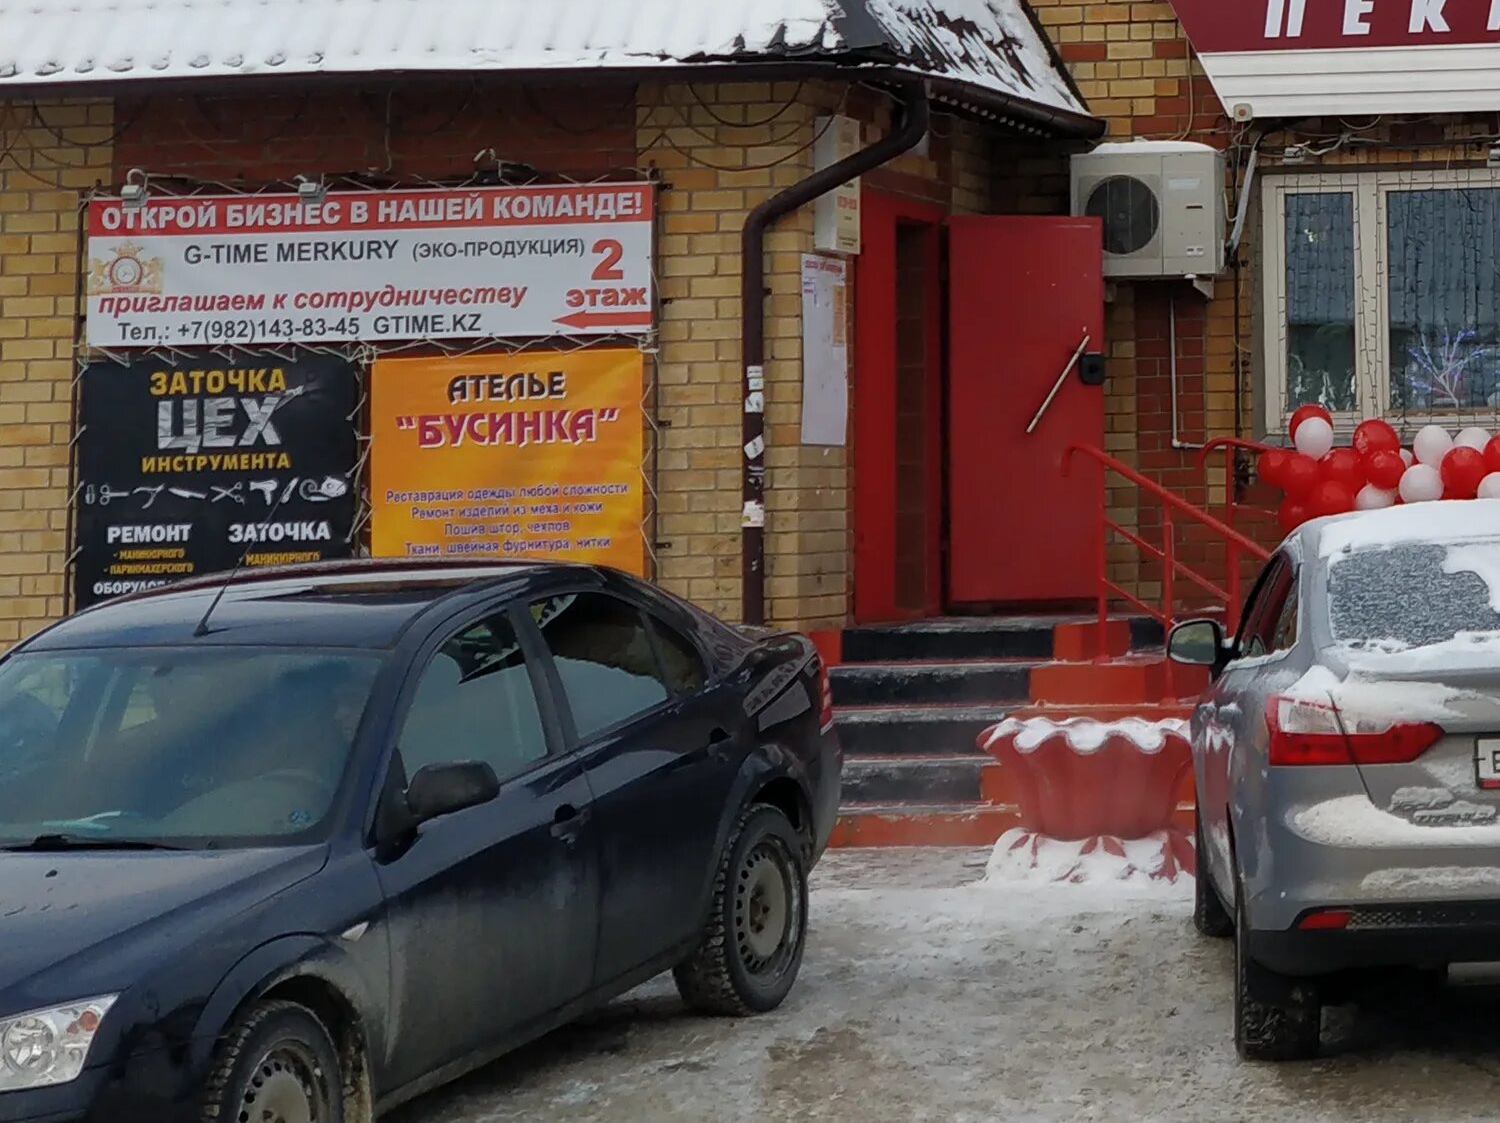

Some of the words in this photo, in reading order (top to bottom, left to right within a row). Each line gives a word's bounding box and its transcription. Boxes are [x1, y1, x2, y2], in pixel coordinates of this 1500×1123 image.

[102, 200, 217, 229] ОТКРОЙ
[226, 201, 342, 228] БИЗНЕС
[350, 200, 369, 225] В
[378, 193, 484, 223] НАШЕЙ
[493, 192, 642, 221] КОМАНДЕ!
[184, 242, 268, 264] G-TIME
[276, 239, 399, 263] MERKURY
[412, 238, 586, 262] (ЭКО-ПРОДУКЦИЯ)
[591, 238, 624, 281] 2
[98, 291, 265, 318] приглашаем
[272, 292, 289, 310] к
[293, 284, 528, 314] сотрудничеству
[565, 286, 648, 308] этаж
[118, 322, 170, 341] Тел.:
[178, 317, 360, 344] +7(982)143-83-45
[373, 313, 482, 334] GTIME.KZ
[150, 368, 287, 396] ЗАТОЧКА
[447, 371, 568, 406] АТЕЛЬЕ
[158, 396, 282, 454] ЦЕХ
[395, 407, 620, 448] "БУСИНКА"
[142, 452, 291, 474] ИНСТРУМЕНТА
[386, 490, 464, 503] Реставрация
[468, 487, 515, 500] одежды
[519, 484, 560, 497] любой
[562, 484, 629, 496] сложности
[411, 506, 456, 519] Ремонт
[459, 504, 509, 519] изделий
[513, 506, 527, 515] из
[530, 503, 559, 514] меха
[574, 502, 603, 513] кожи
[107, 523, 193, 545] РЕМОНТ
[228, 521, 332, 544] ЗАТОЧКА
[444, 522, 485, 536] Пошив
[526, 521, 571, 533] чехлов
[447, 540, 499, 554] швейная
[576, 537, 611, 549] нитки
